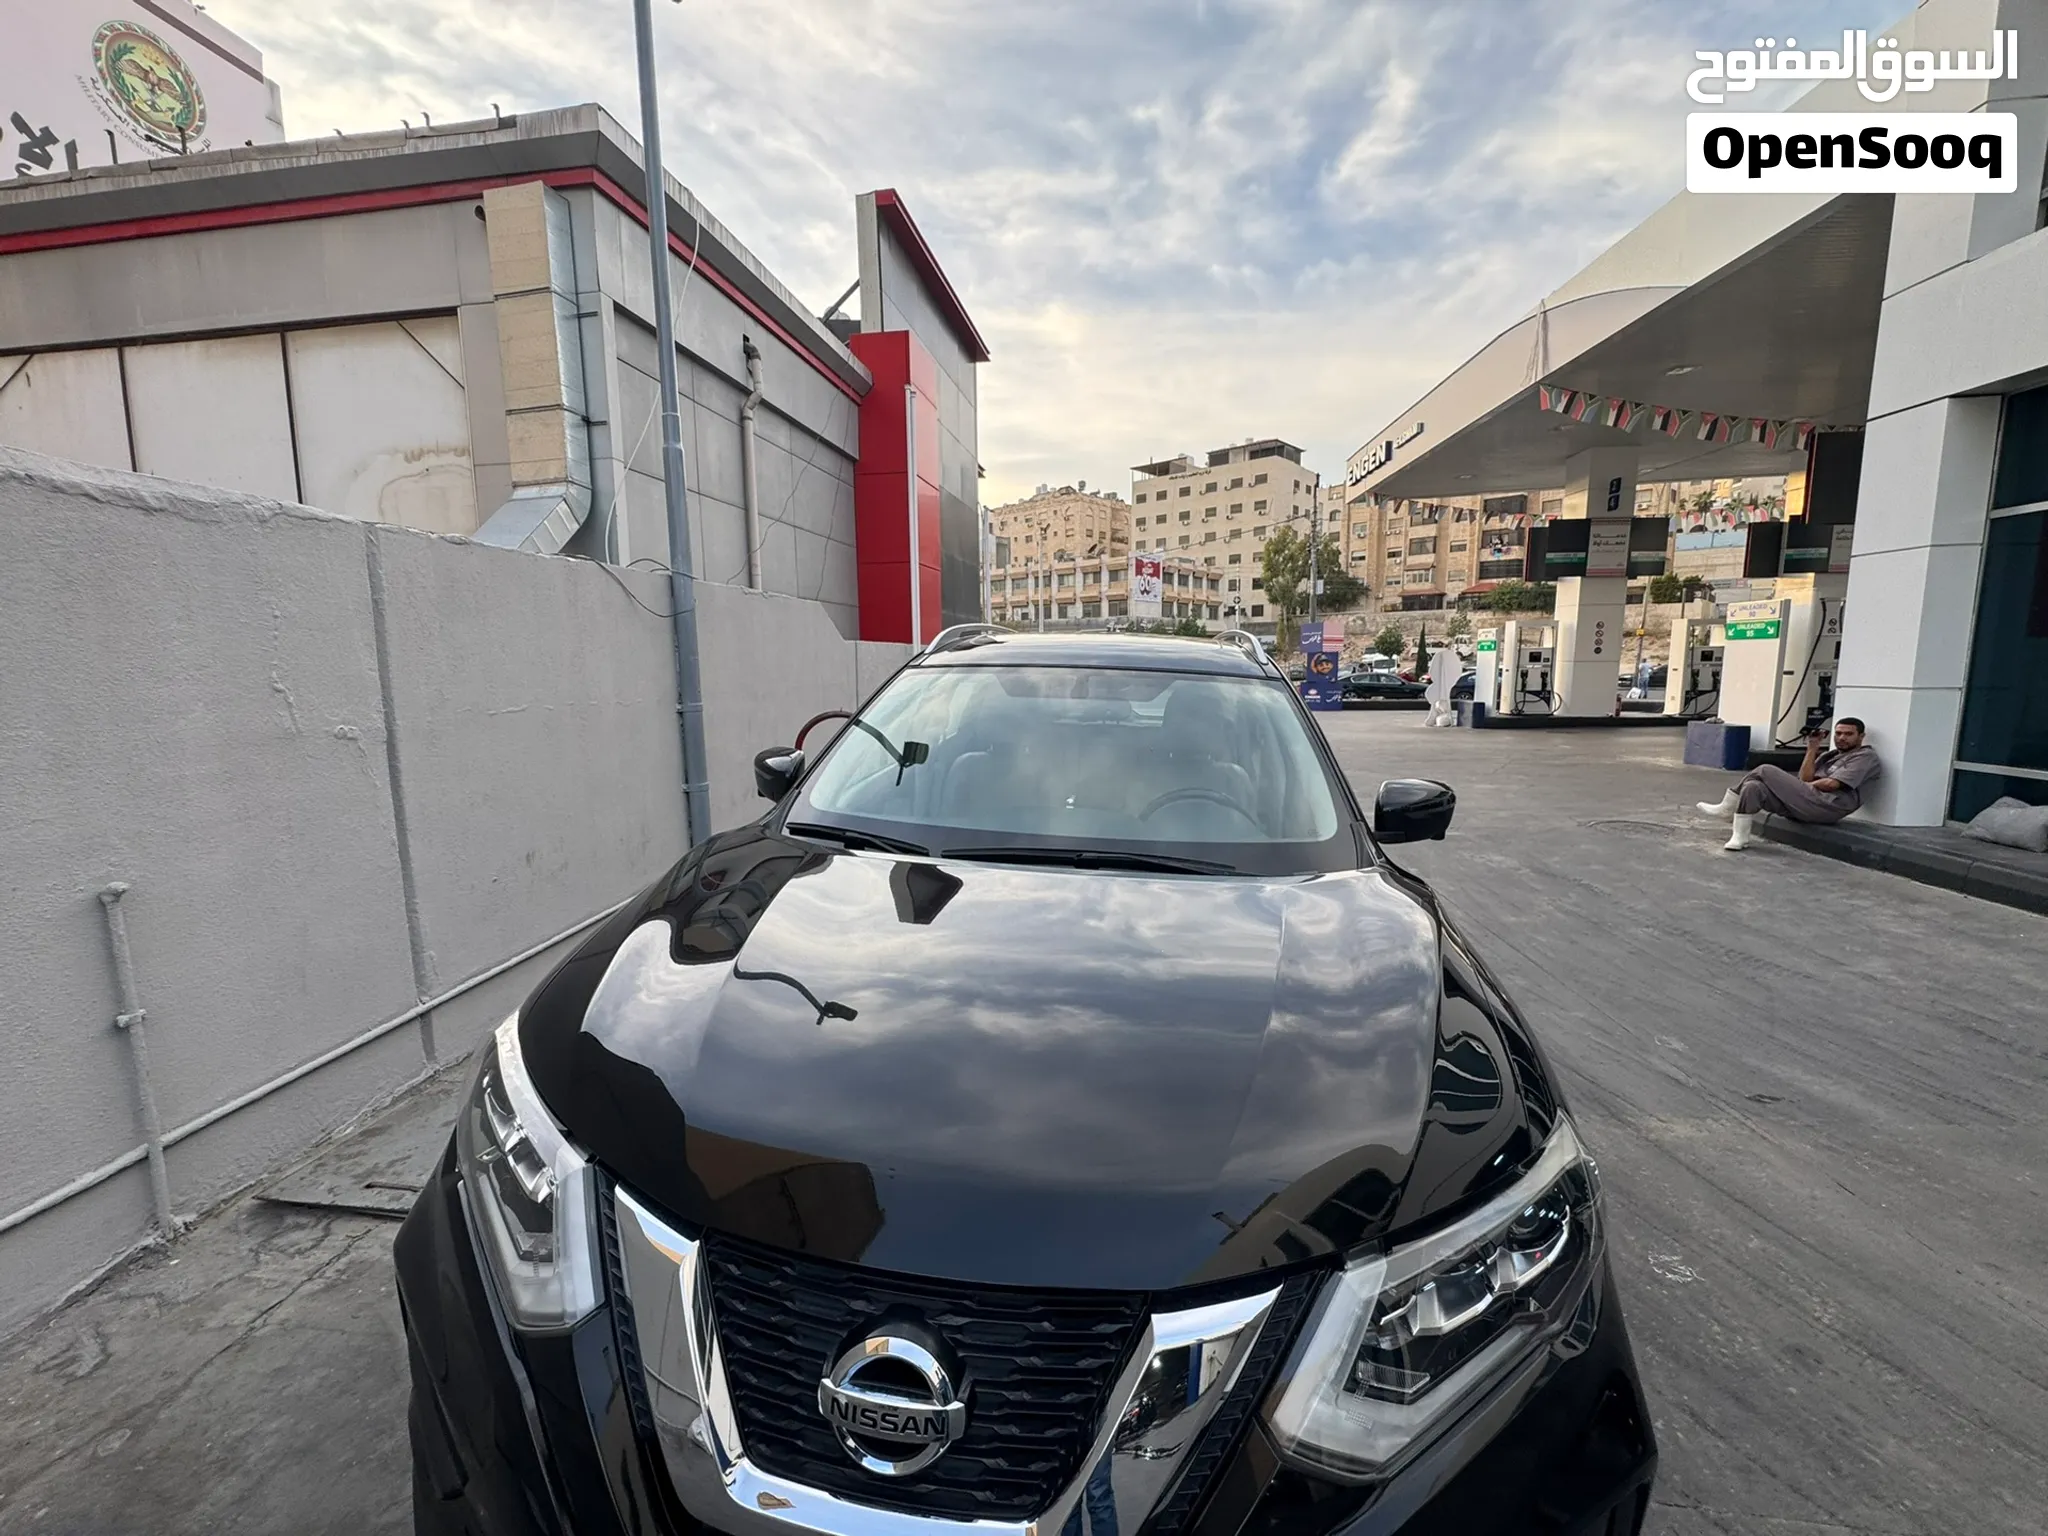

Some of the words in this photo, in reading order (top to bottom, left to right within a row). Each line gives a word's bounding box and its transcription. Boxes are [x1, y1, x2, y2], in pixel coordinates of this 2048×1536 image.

[75, 74, 114, 122] MILITARY
[1347, 441, 1392, 486] ENGEN
[830, 1396, 946, 1437] NISSAN
